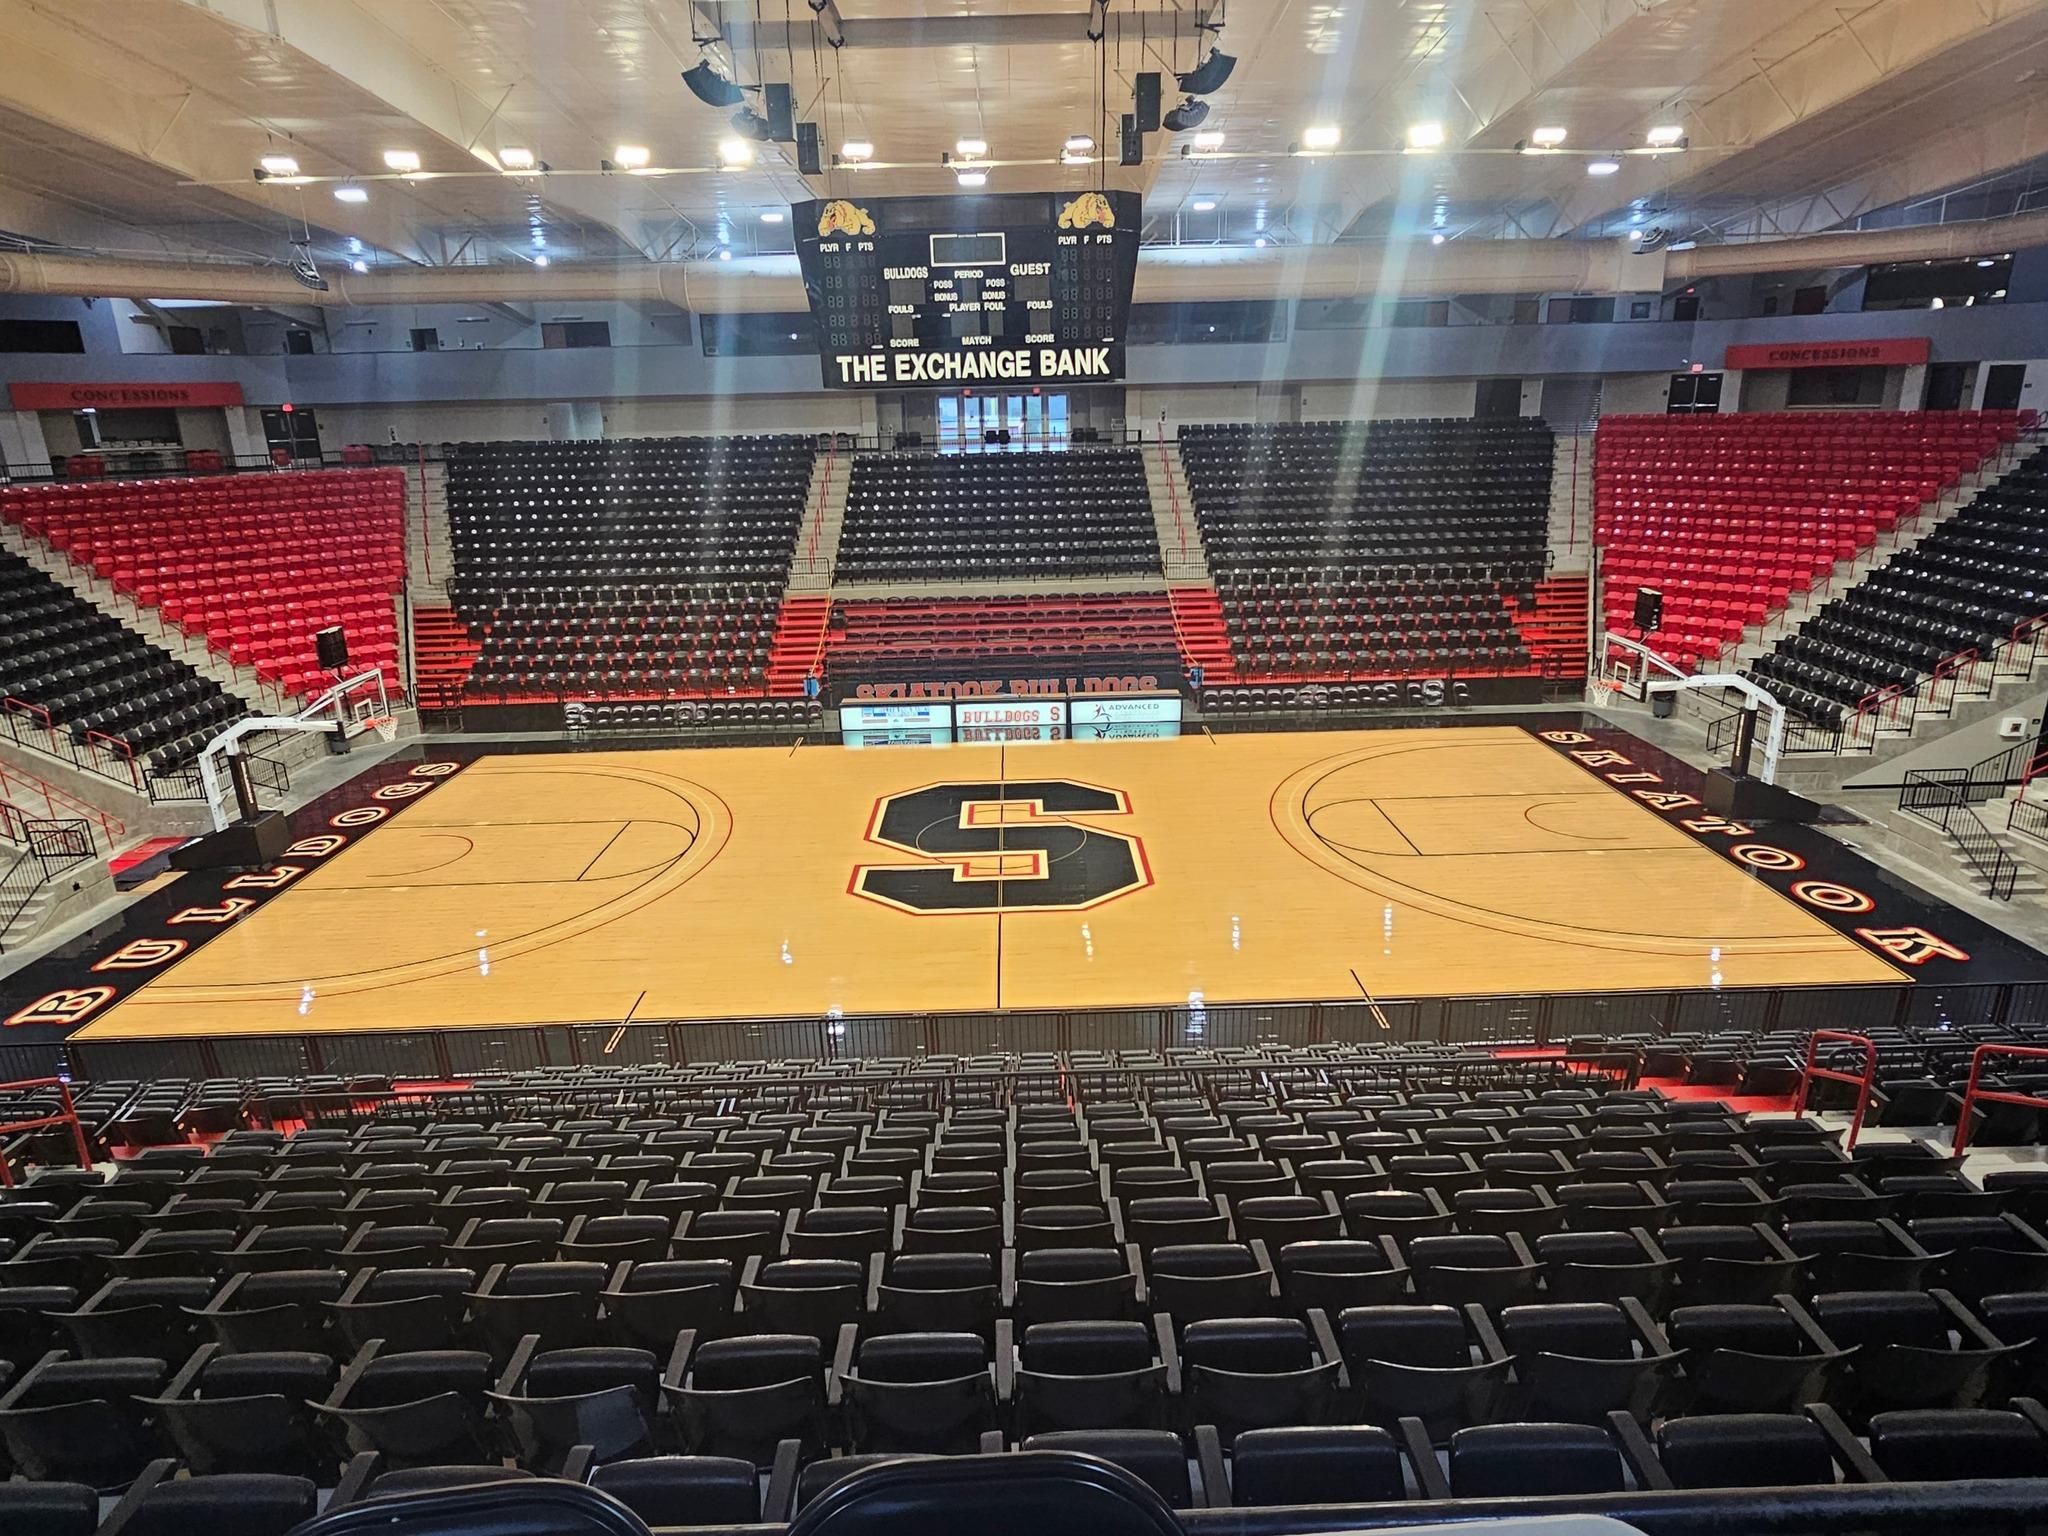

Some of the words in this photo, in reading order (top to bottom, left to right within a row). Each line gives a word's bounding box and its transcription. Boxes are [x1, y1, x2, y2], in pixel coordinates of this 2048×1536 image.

[1058, 235, 1077, 245] PLYR
[1083, 235, 1090, 245] F
[1096, 234, 1112, 244] PTS
[820, 243, 839, 252] PLYR
[845, 243, 852, 252] F
[858, 242, 874, 252] PTS
[883, 266, 929, 279] BULLDOGS
[954, 270, 984, 279] PERIOD
[1010, 263, 1051, 276] GUEST
[933, 280, 953, 289] POSS
[986, 279, 1005, 288] POSS
[934, 292, 958, 301] BONUS
[982, 291, 1006, 300] BONUS
[888, 305, 914, 314] FOULS
[949, 302, 981, 312] PLAYER
[984, 301, 1006, 311] FOUL
[1026, 300, 1053, 310] FOULS
[890, 338, 920, 347] SCORE
[961, 335, 992, 346] MATCH
[1025, 334, 1055, 343] SCORE
[1768, 346, 1881, 361] CONCESSIONS
[836, 354, 887, 383] THE
[894, 349, 1031, 381] EXCHANGE
[1040, 347, 1110, 377] BANK
[71, 388, 190, 401] CONCESSIONS
[1108, 703, 1160, 711] ADVANCED
[963, 709, 1040, 724] BULLDOGS
[1050, 706, 1061, 721] S
[846, 777, 1156, 916] S
[1538, 731, 1970, 965] SKIATOOK
[3, 762, 461, 1026] BULLDOGS
